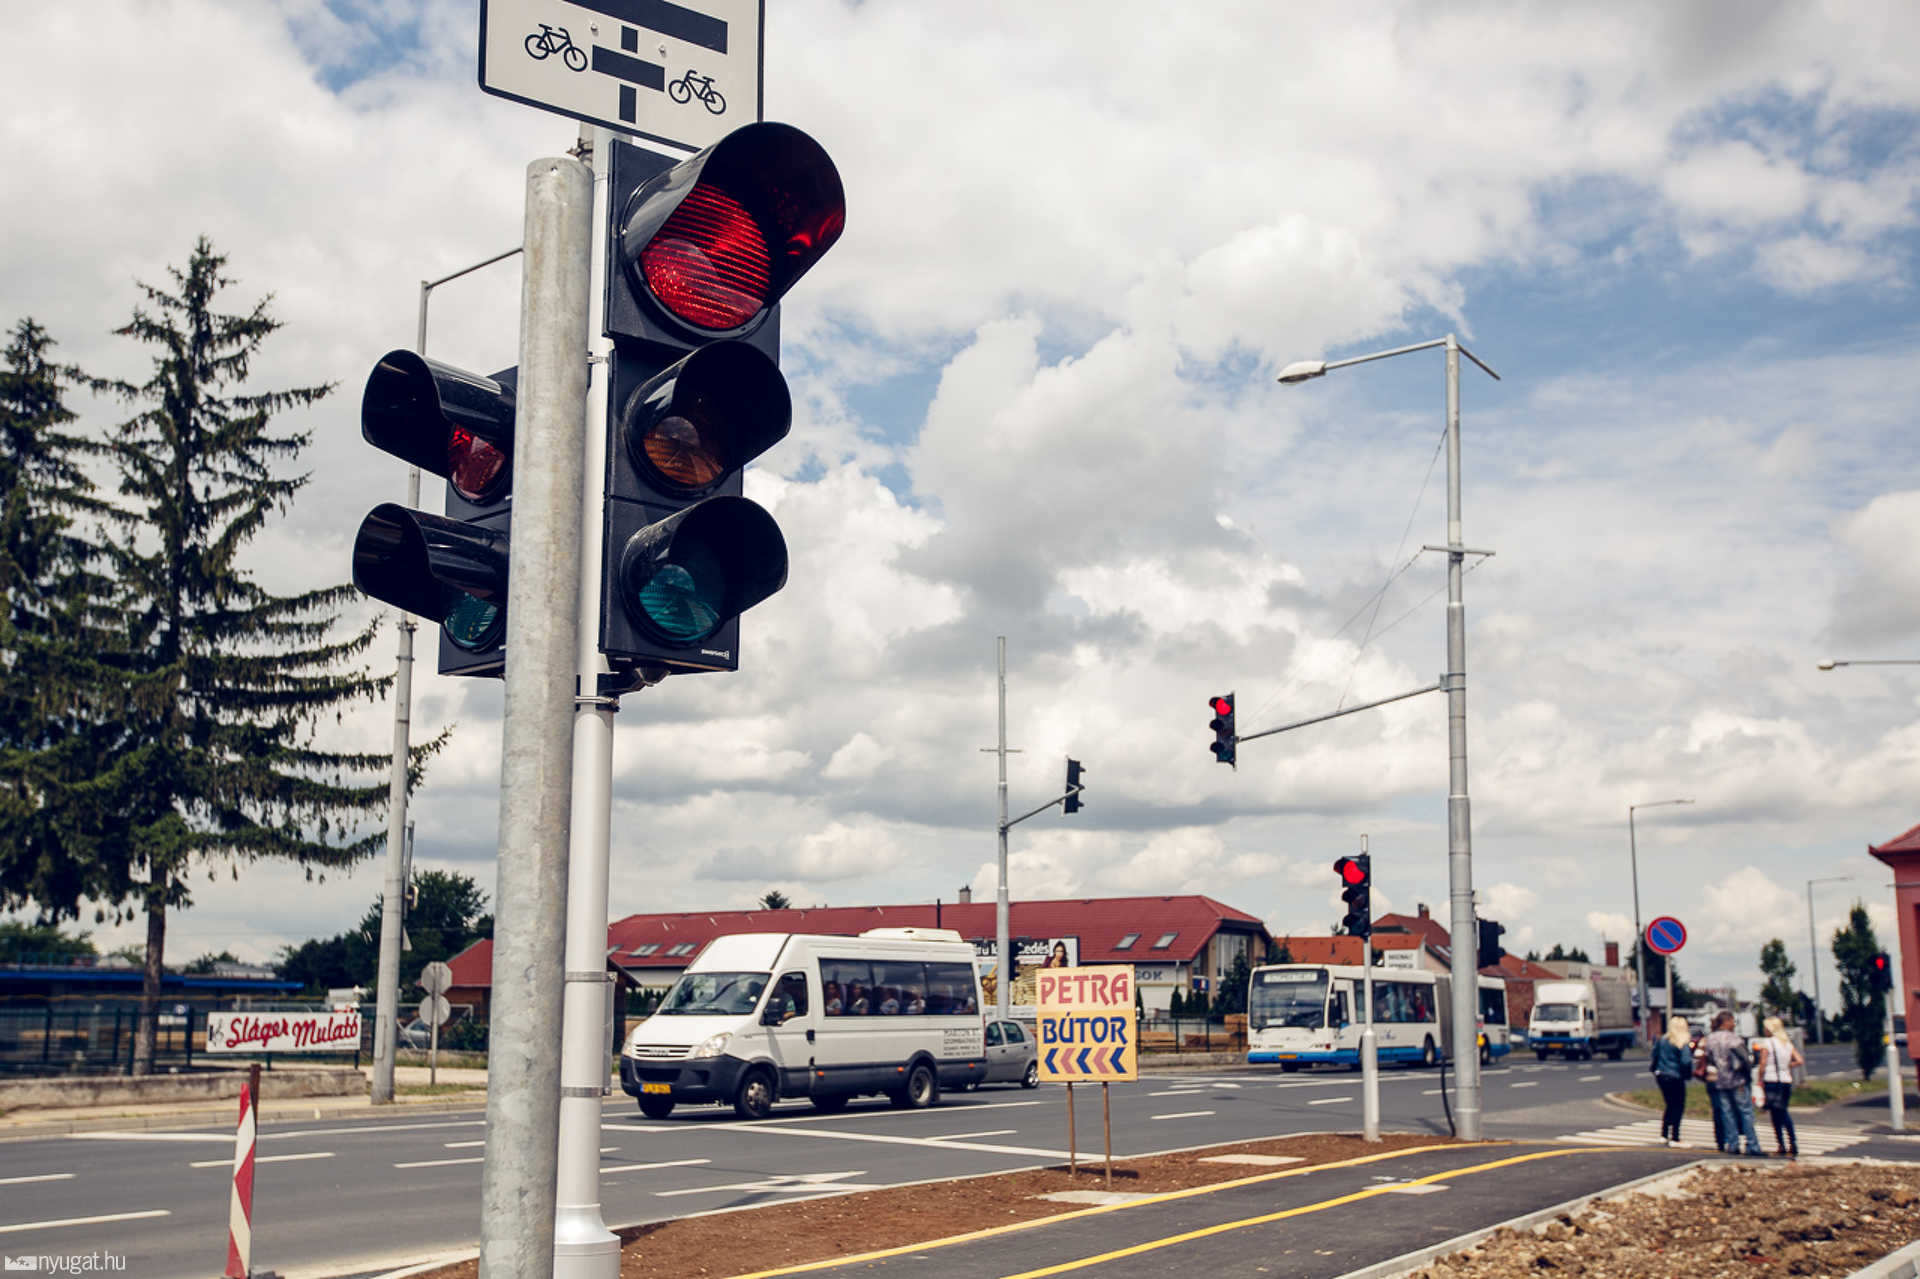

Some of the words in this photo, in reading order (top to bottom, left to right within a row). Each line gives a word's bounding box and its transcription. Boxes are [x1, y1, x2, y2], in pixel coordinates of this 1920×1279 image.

[1040, 973, 1128, 1006] PETRA
[226, 1016, 289, 1048] Sláger
[1042, 1012, 1128, 1045] BÚTOR
